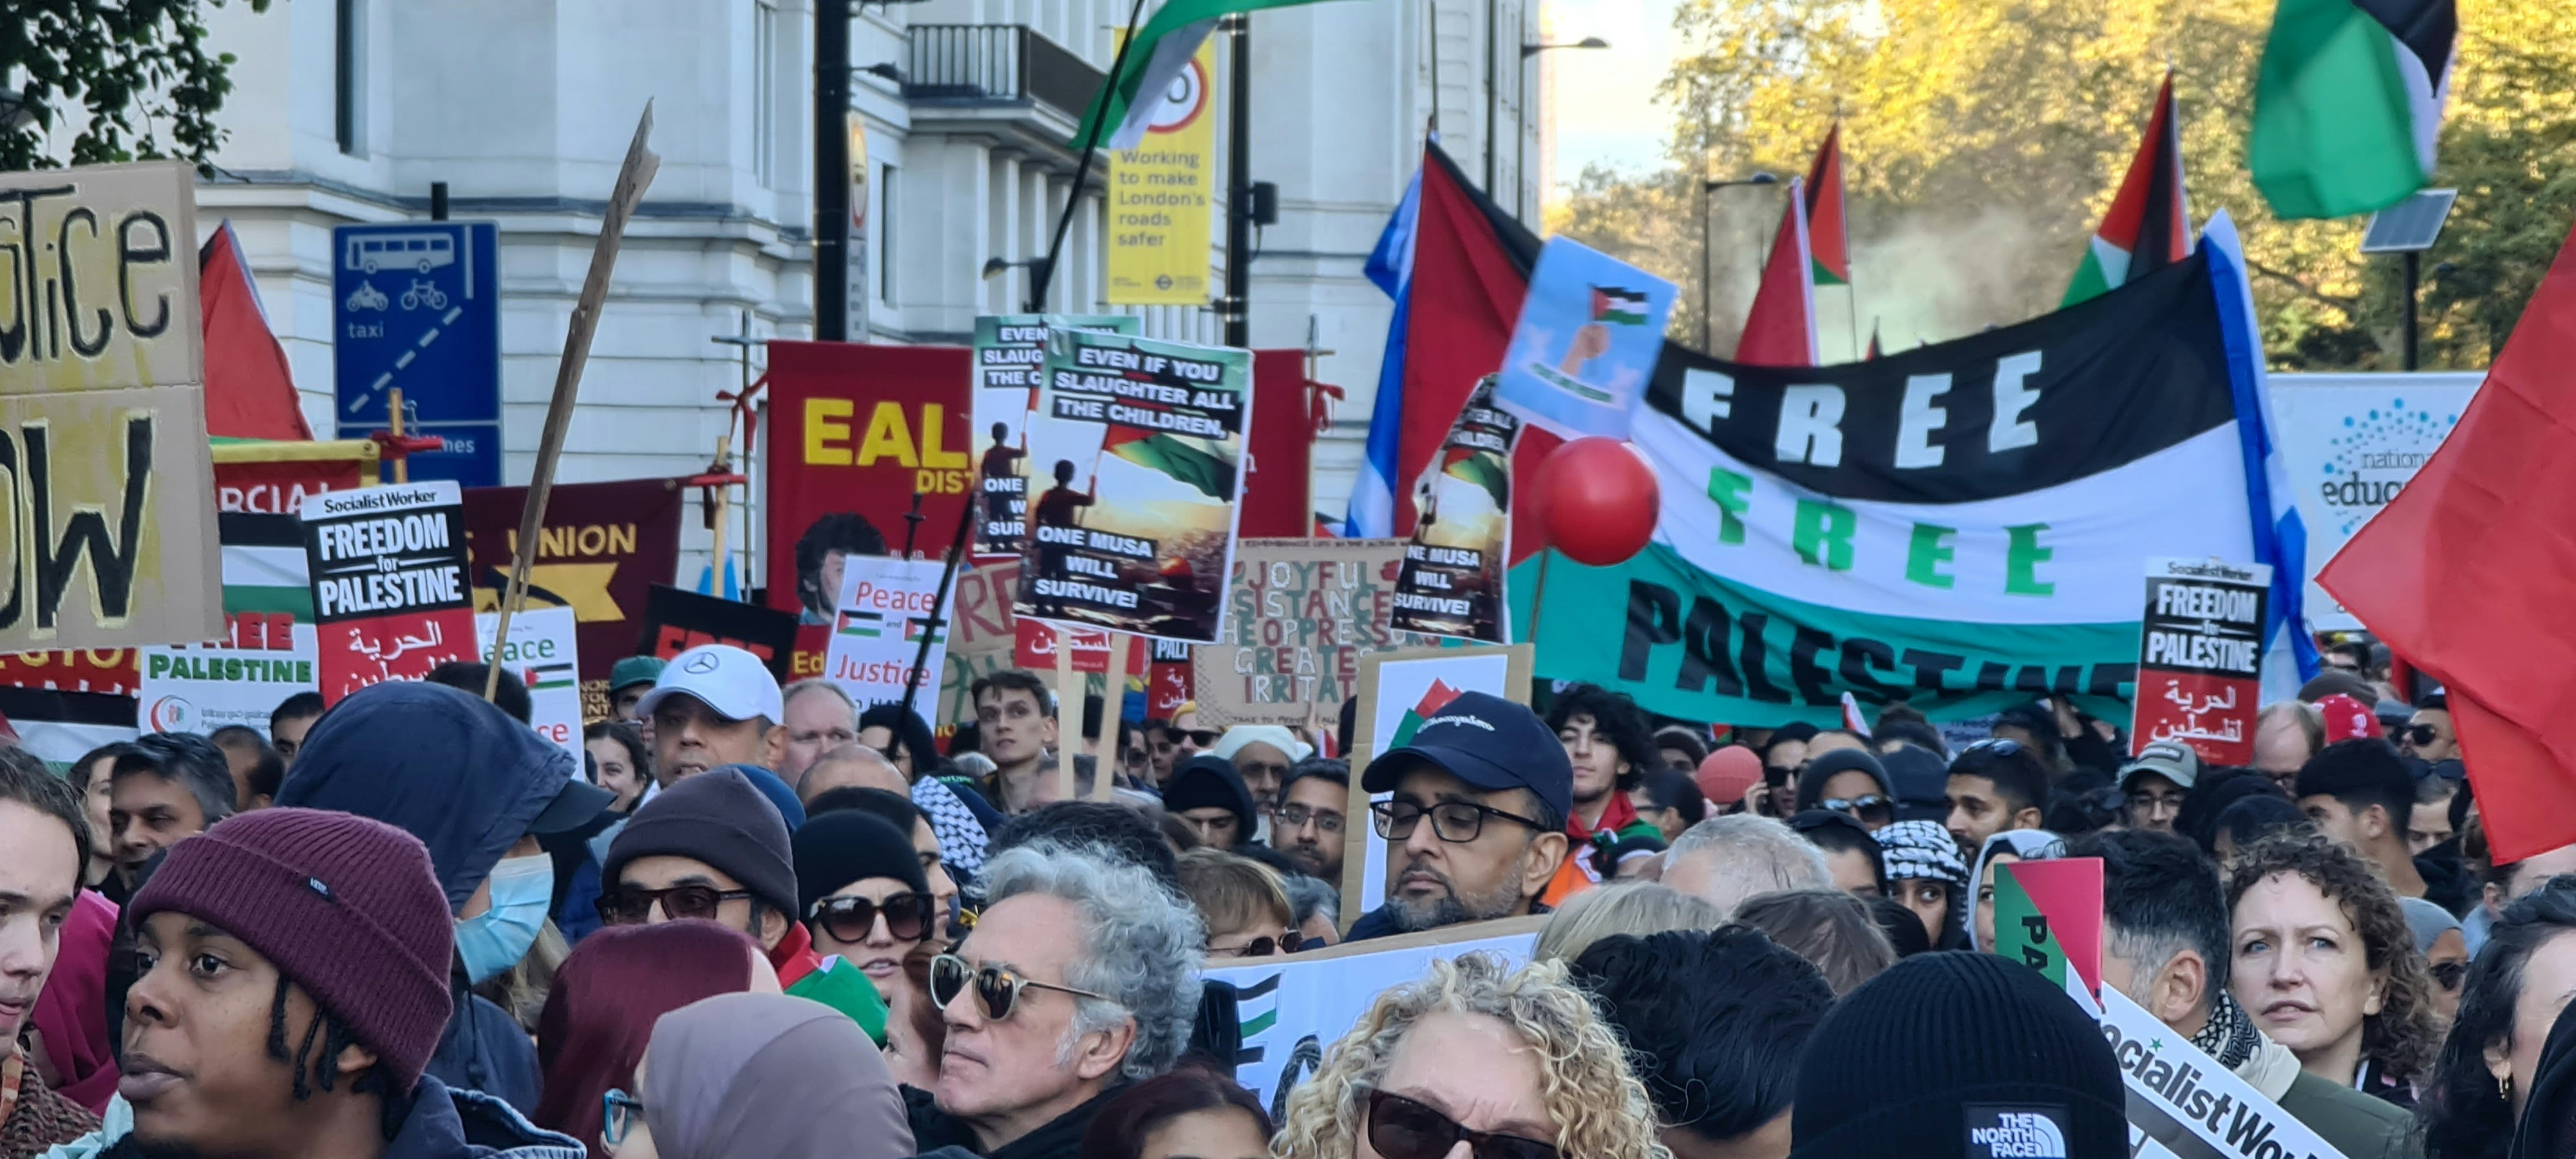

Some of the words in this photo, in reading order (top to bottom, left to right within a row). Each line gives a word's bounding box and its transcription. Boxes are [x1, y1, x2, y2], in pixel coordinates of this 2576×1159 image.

[1121, 149, 1199, 169] Working
[1119, 173, 1139, 185] to
[1147, 172, 1198, 186] make
[1119, 191, 1205, 206] London's
[1119, 212, 1171, 226] roads
[1117, 232, 1166, 246] safer
[348, 321, 384, 338] taxi
[1000, 326, 1048, 341] EVEN
[984, 349, 1044, 364] SLAUG
[1078, 348, 1139, 370] EVEN
[1144, 355, 1167, 373] IF
[1171, 359, 1218, 381] YOU
[988, 371, 1024, 385] THE
[1030, 371, 1041, 385] C
[1056, 371, 1188, 405] SLAUGHTER
[1193, 391, 1235, 410] ALL
[1057, 397, 1104, 418] THE
[1108, 405, 1227, 438] CHILDREN,
[1680, 349, 2043, 471] FREE
[805, 398, 967, 468] EAL
[2362, 449, 2432, 469] nation
[985, 478, 1023, 492] ONE
[2322, 471, 2403, 507] educ
[325, 493, 385, 513] Socialist
[386, 489, 437, 507] Worker
[1009, 500, 1027, 513] W
[318, 513, 450, 561] FREEDOM
[987, 522, 1025, 536] SUR
[1036, 525, 1086, 545] ONE
[1089, 532, 1153, 558] MUSA
[1707, 466, 2054, 596] FREE
[376, 554, 400, 573] for
[1065, 554, 1119, 579] WILL
[1406, 544, 1425, 561] NE
[1429, 548, 1481, 568] MUSA
[1249, 561, 1378, 590] JOYFUL
[1415, 570, 1452, 589] WILL
[318, 565, 464, 617] PALESTINE
[855, 581, 937, 612] Peace
[1034, 578, 1139, 608] SURVIVE!
[1229, 589, 1391, 618] SISTANCE
[2157, 583, 2257, 624] FREEDOM
[1394, 592, 1470, 616] SURVIVE!
[886, 621, 902, 629] and
[1222, 614, 1257, 646] HE
[2201, 619, 2221, 636] for
[348, 619, 443, 661] الحرية
[484, 638, 556, 664] eace
[2146, 630, 2257, 674] PALESTINE
[149, 654, 312, 683] PALESTINE
[794, 651, 825, 675] Ed
[835, 654, 931, 688] Justice
[1245, 675, 1356, 704] IRRITAT
[2021, 915, 2048, 970] PA
[2102, 1022, 2233, 1133] ocialist
[2226, 1102, 2321, 1159] Wo
[1998, 1113, 2032, 1128] THE
[1971, 1128, 2034, 1144] NORTH
[1991, 1142, 2035, 1158] FACE
